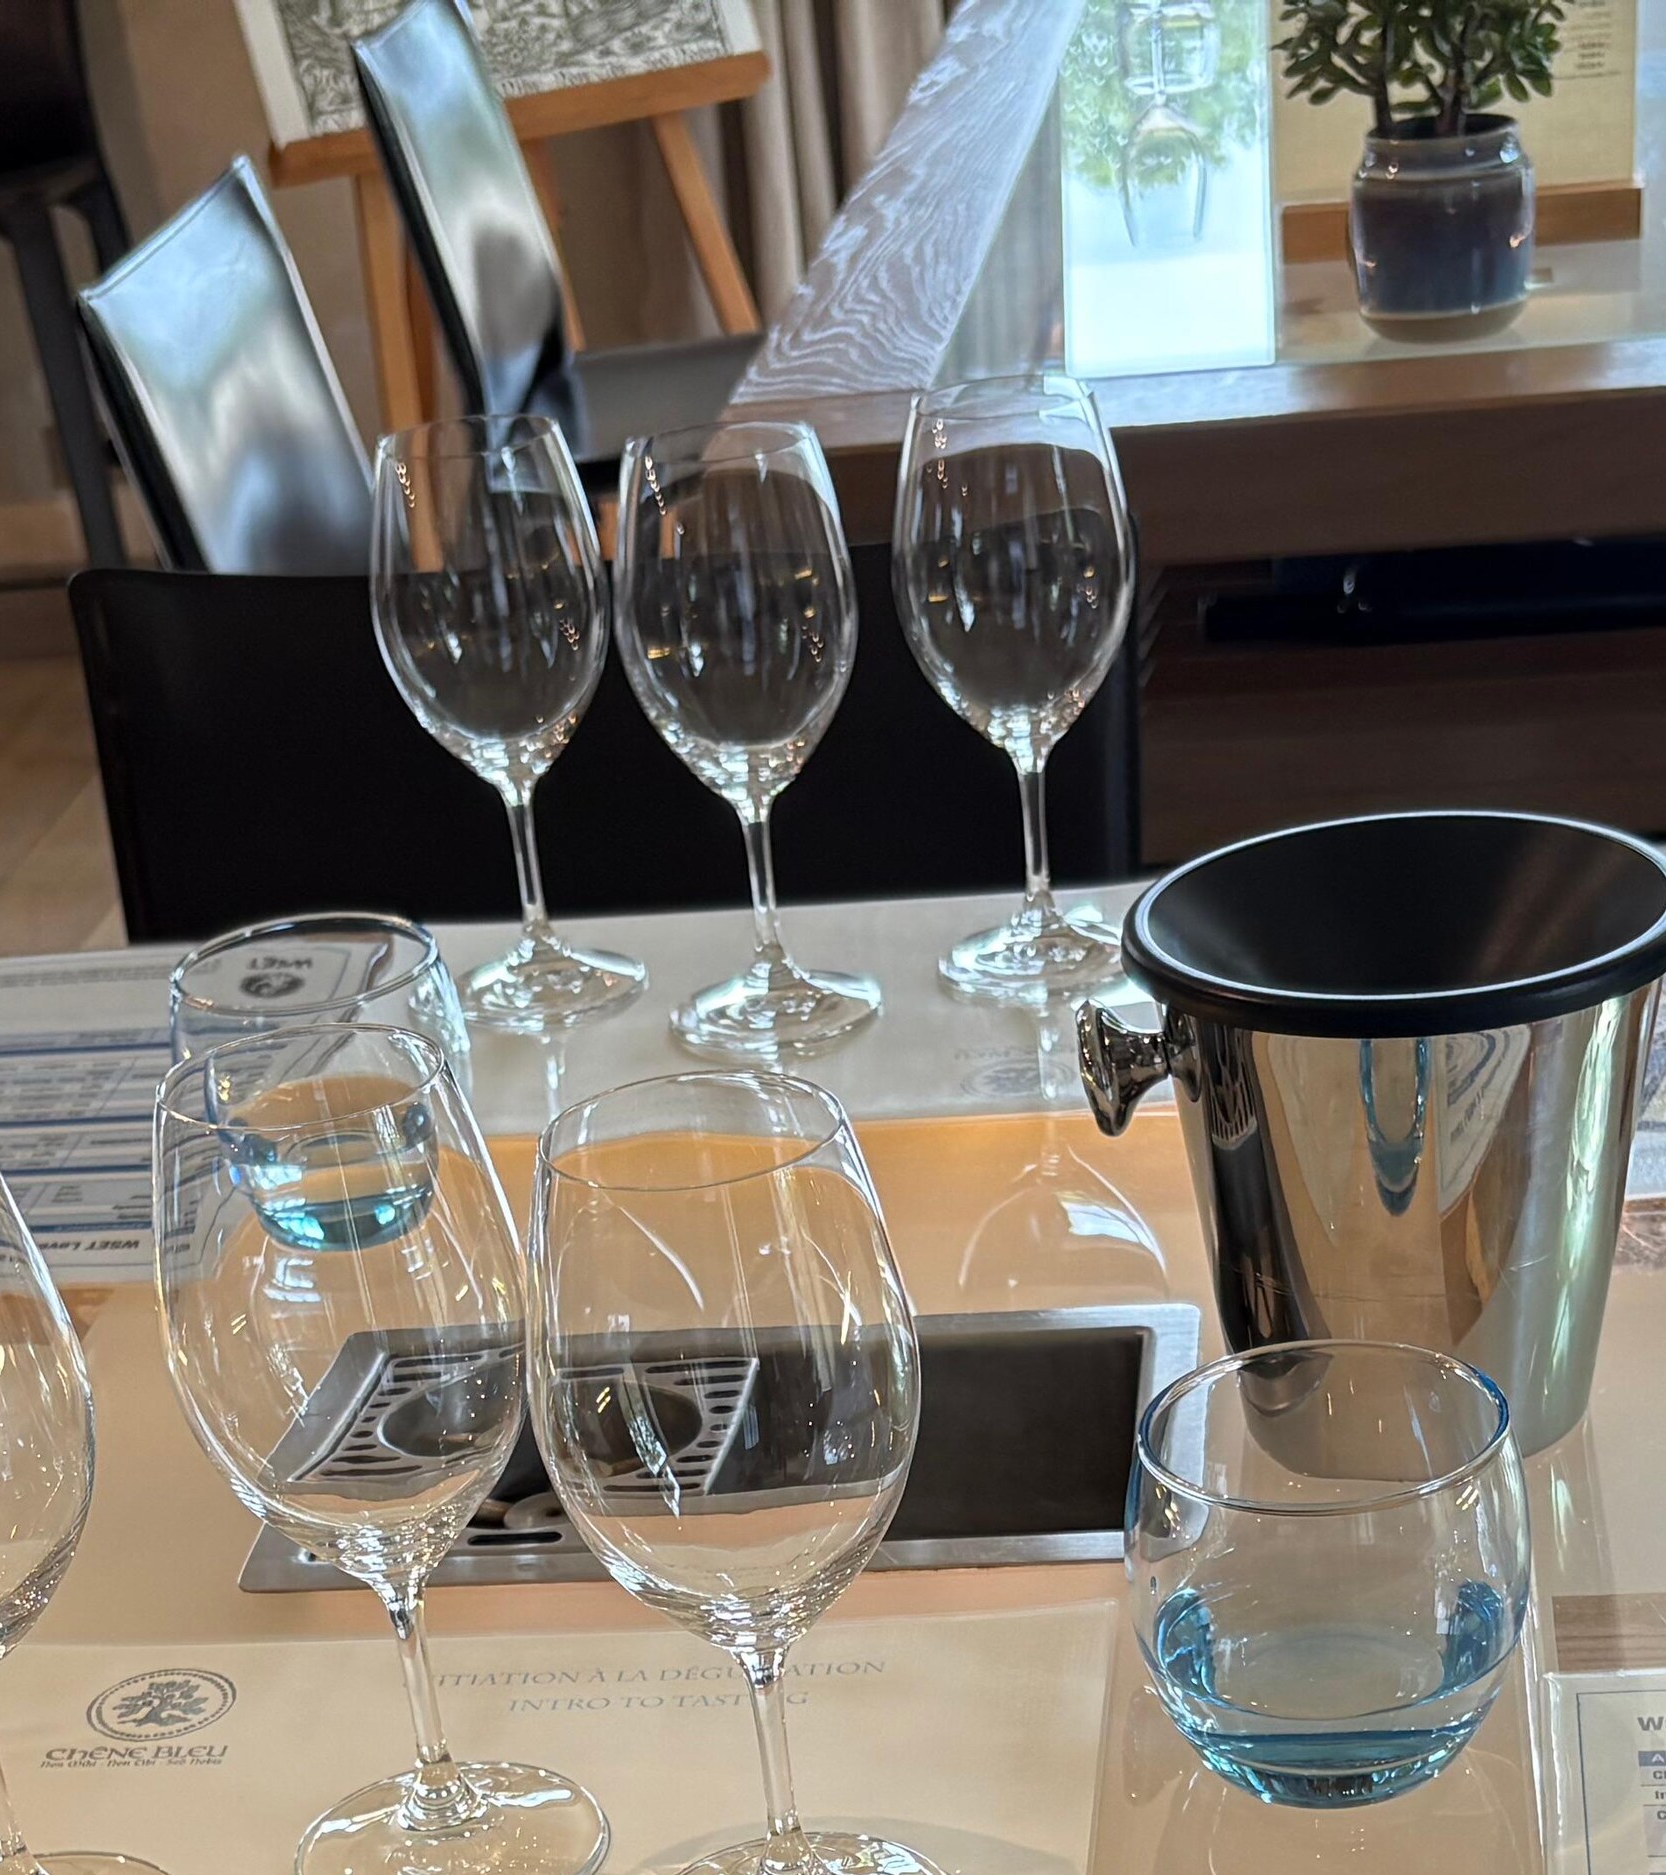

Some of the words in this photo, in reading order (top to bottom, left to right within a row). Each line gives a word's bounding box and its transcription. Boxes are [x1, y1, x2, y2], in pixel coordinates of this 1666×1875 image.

[617, 1669, 648, 1682] LA
[508, 1696, 610, 1711] INTRO
[621, 1696, 664, 1708] TO
[671, 1692, 810, 1708] TASTG
[152, 1745, 230, 1760] BLEU
